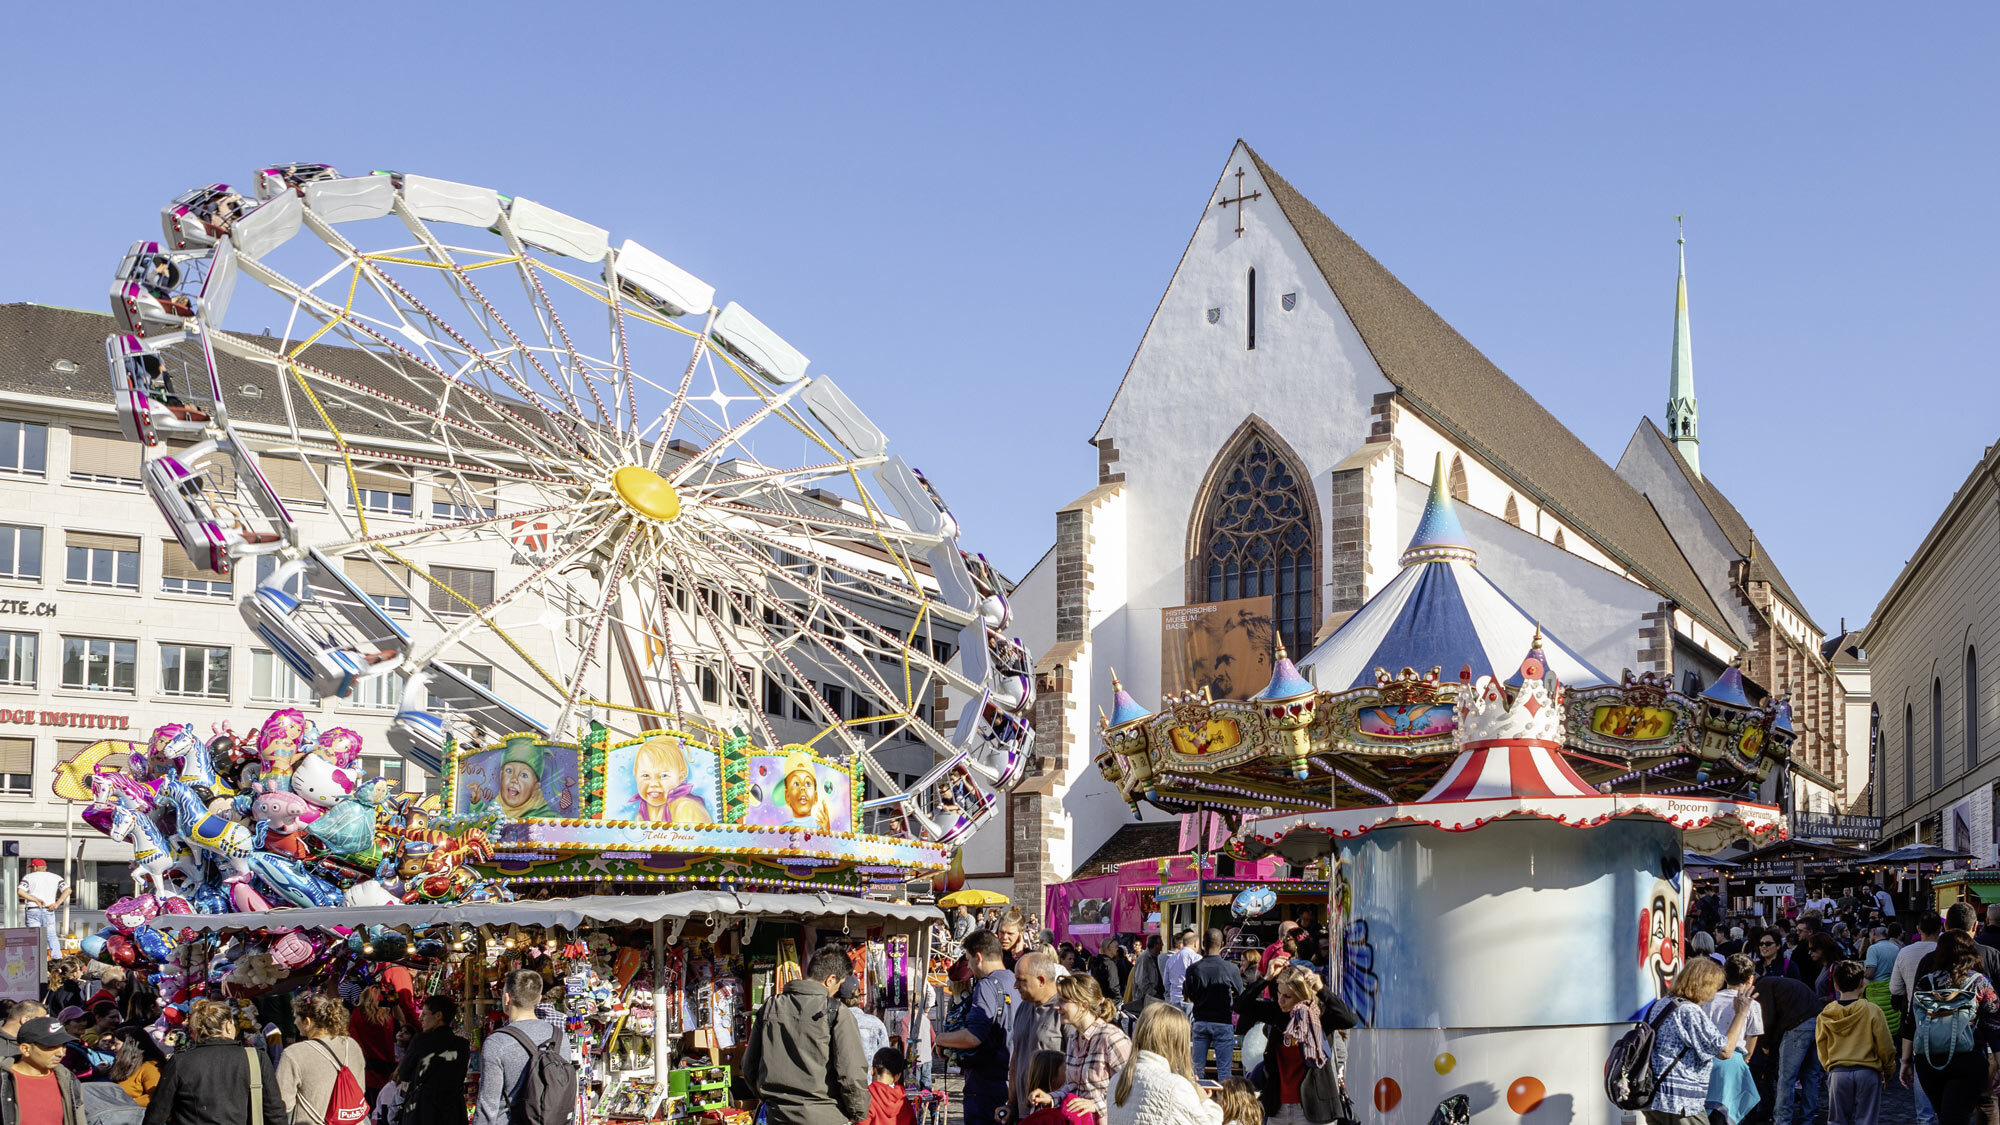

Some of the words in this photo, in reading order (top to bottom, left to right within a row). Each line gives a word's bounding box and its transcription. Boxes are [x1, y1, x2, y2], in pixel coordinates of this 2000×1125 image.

[1165, 605, 1217, 616] HISTORISCHES
[1165, 615, 1198, 624] MUSEUM
[1165, 623, 1188, 631] BASEL
[40, 710, 130, 730] INSTITUTE
[1667, 800, 1709, 814] Popcorn
[1841, 815, 1881, 827] GLÜHWEIN
[642, 830, 668, 840] Tolle
[670, 831, 695, 842] Preise
[1775, 885, 1791, 894] WC
